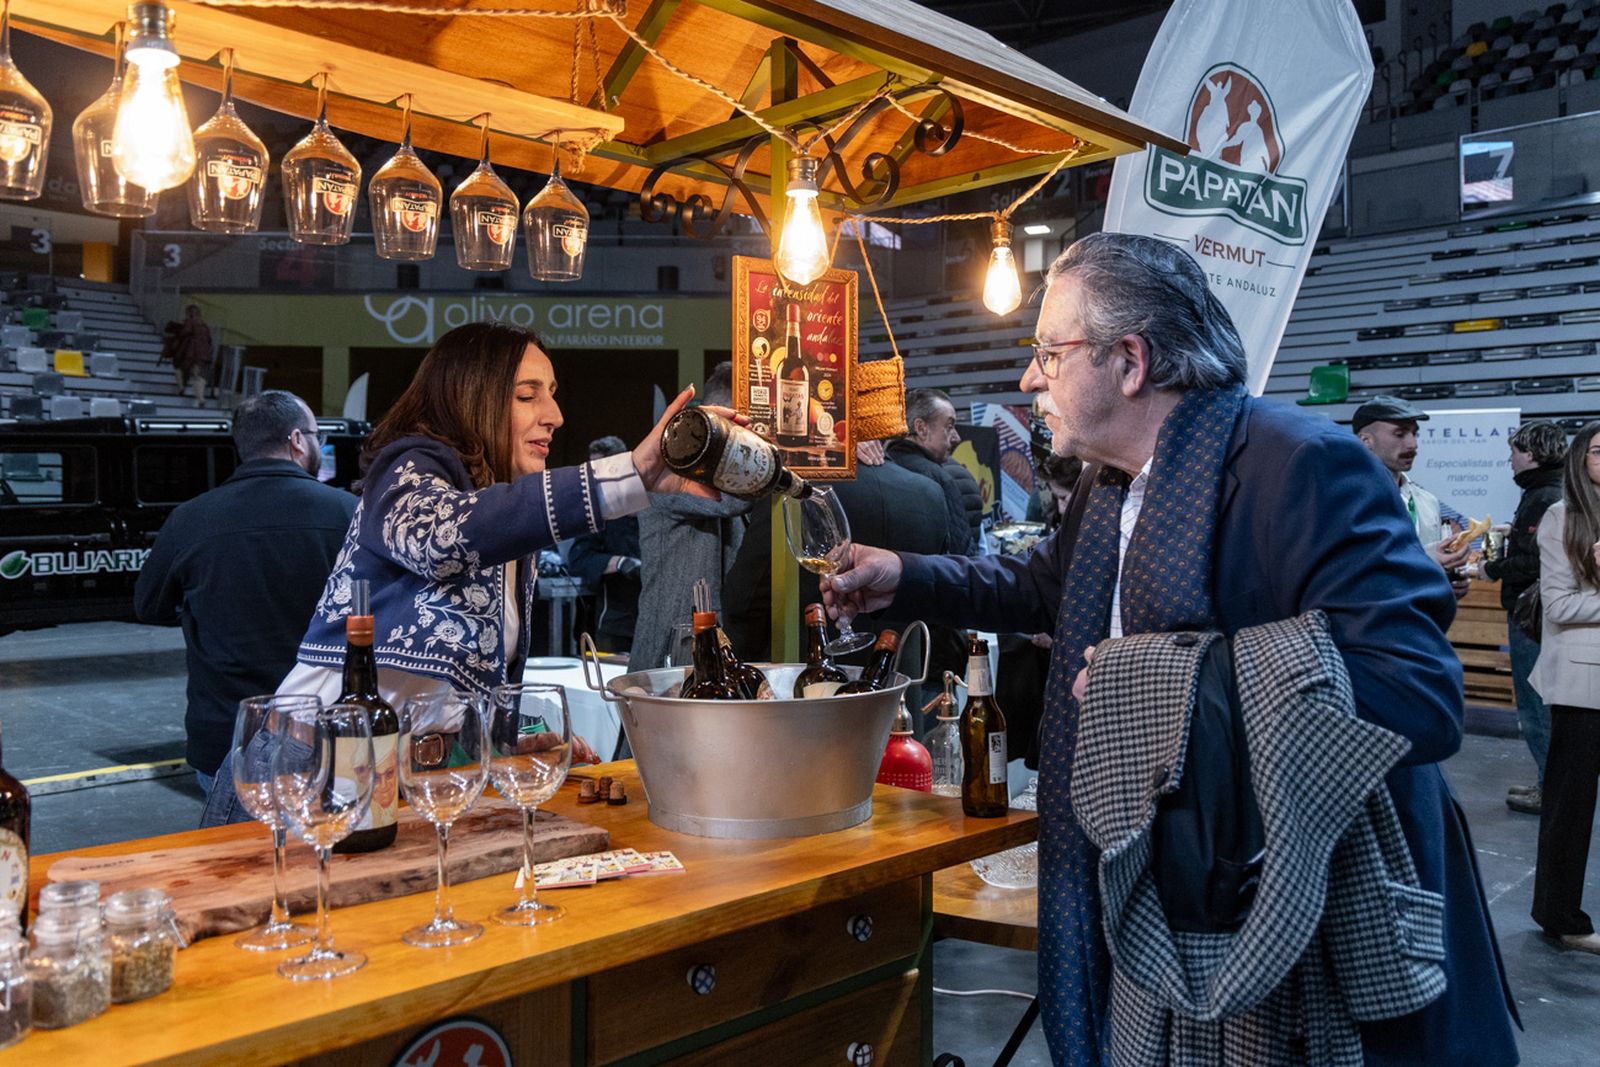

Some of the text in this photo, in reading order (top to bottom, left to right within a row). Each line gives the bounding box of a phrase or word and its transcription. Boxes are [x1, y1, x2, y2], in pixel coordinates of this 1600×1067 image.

[1489, 147, 1514, 180] 7
[31, 229, 51, 254] 3
[1194, 234, 1266, 268] VERMUT
[164, 243, 181, 268] 3
[772, 283, 829, 304] intensidad
[1227, 277, 1276, 297] ANDALUZ
[444, 296, 664, 329] olivo arena
[806, 309, 843, 325] oriente
[609, 334, 664, 346] INTERIOR
[1416, 427, 1517, 438] TELLA
[1426, 458, 1510, 469] Especialistas en
[1446, 473, 1489, 482] marisco
[1451, 487, 1488, 497] cocido
[31, 549, 152, 576] BUJARK
